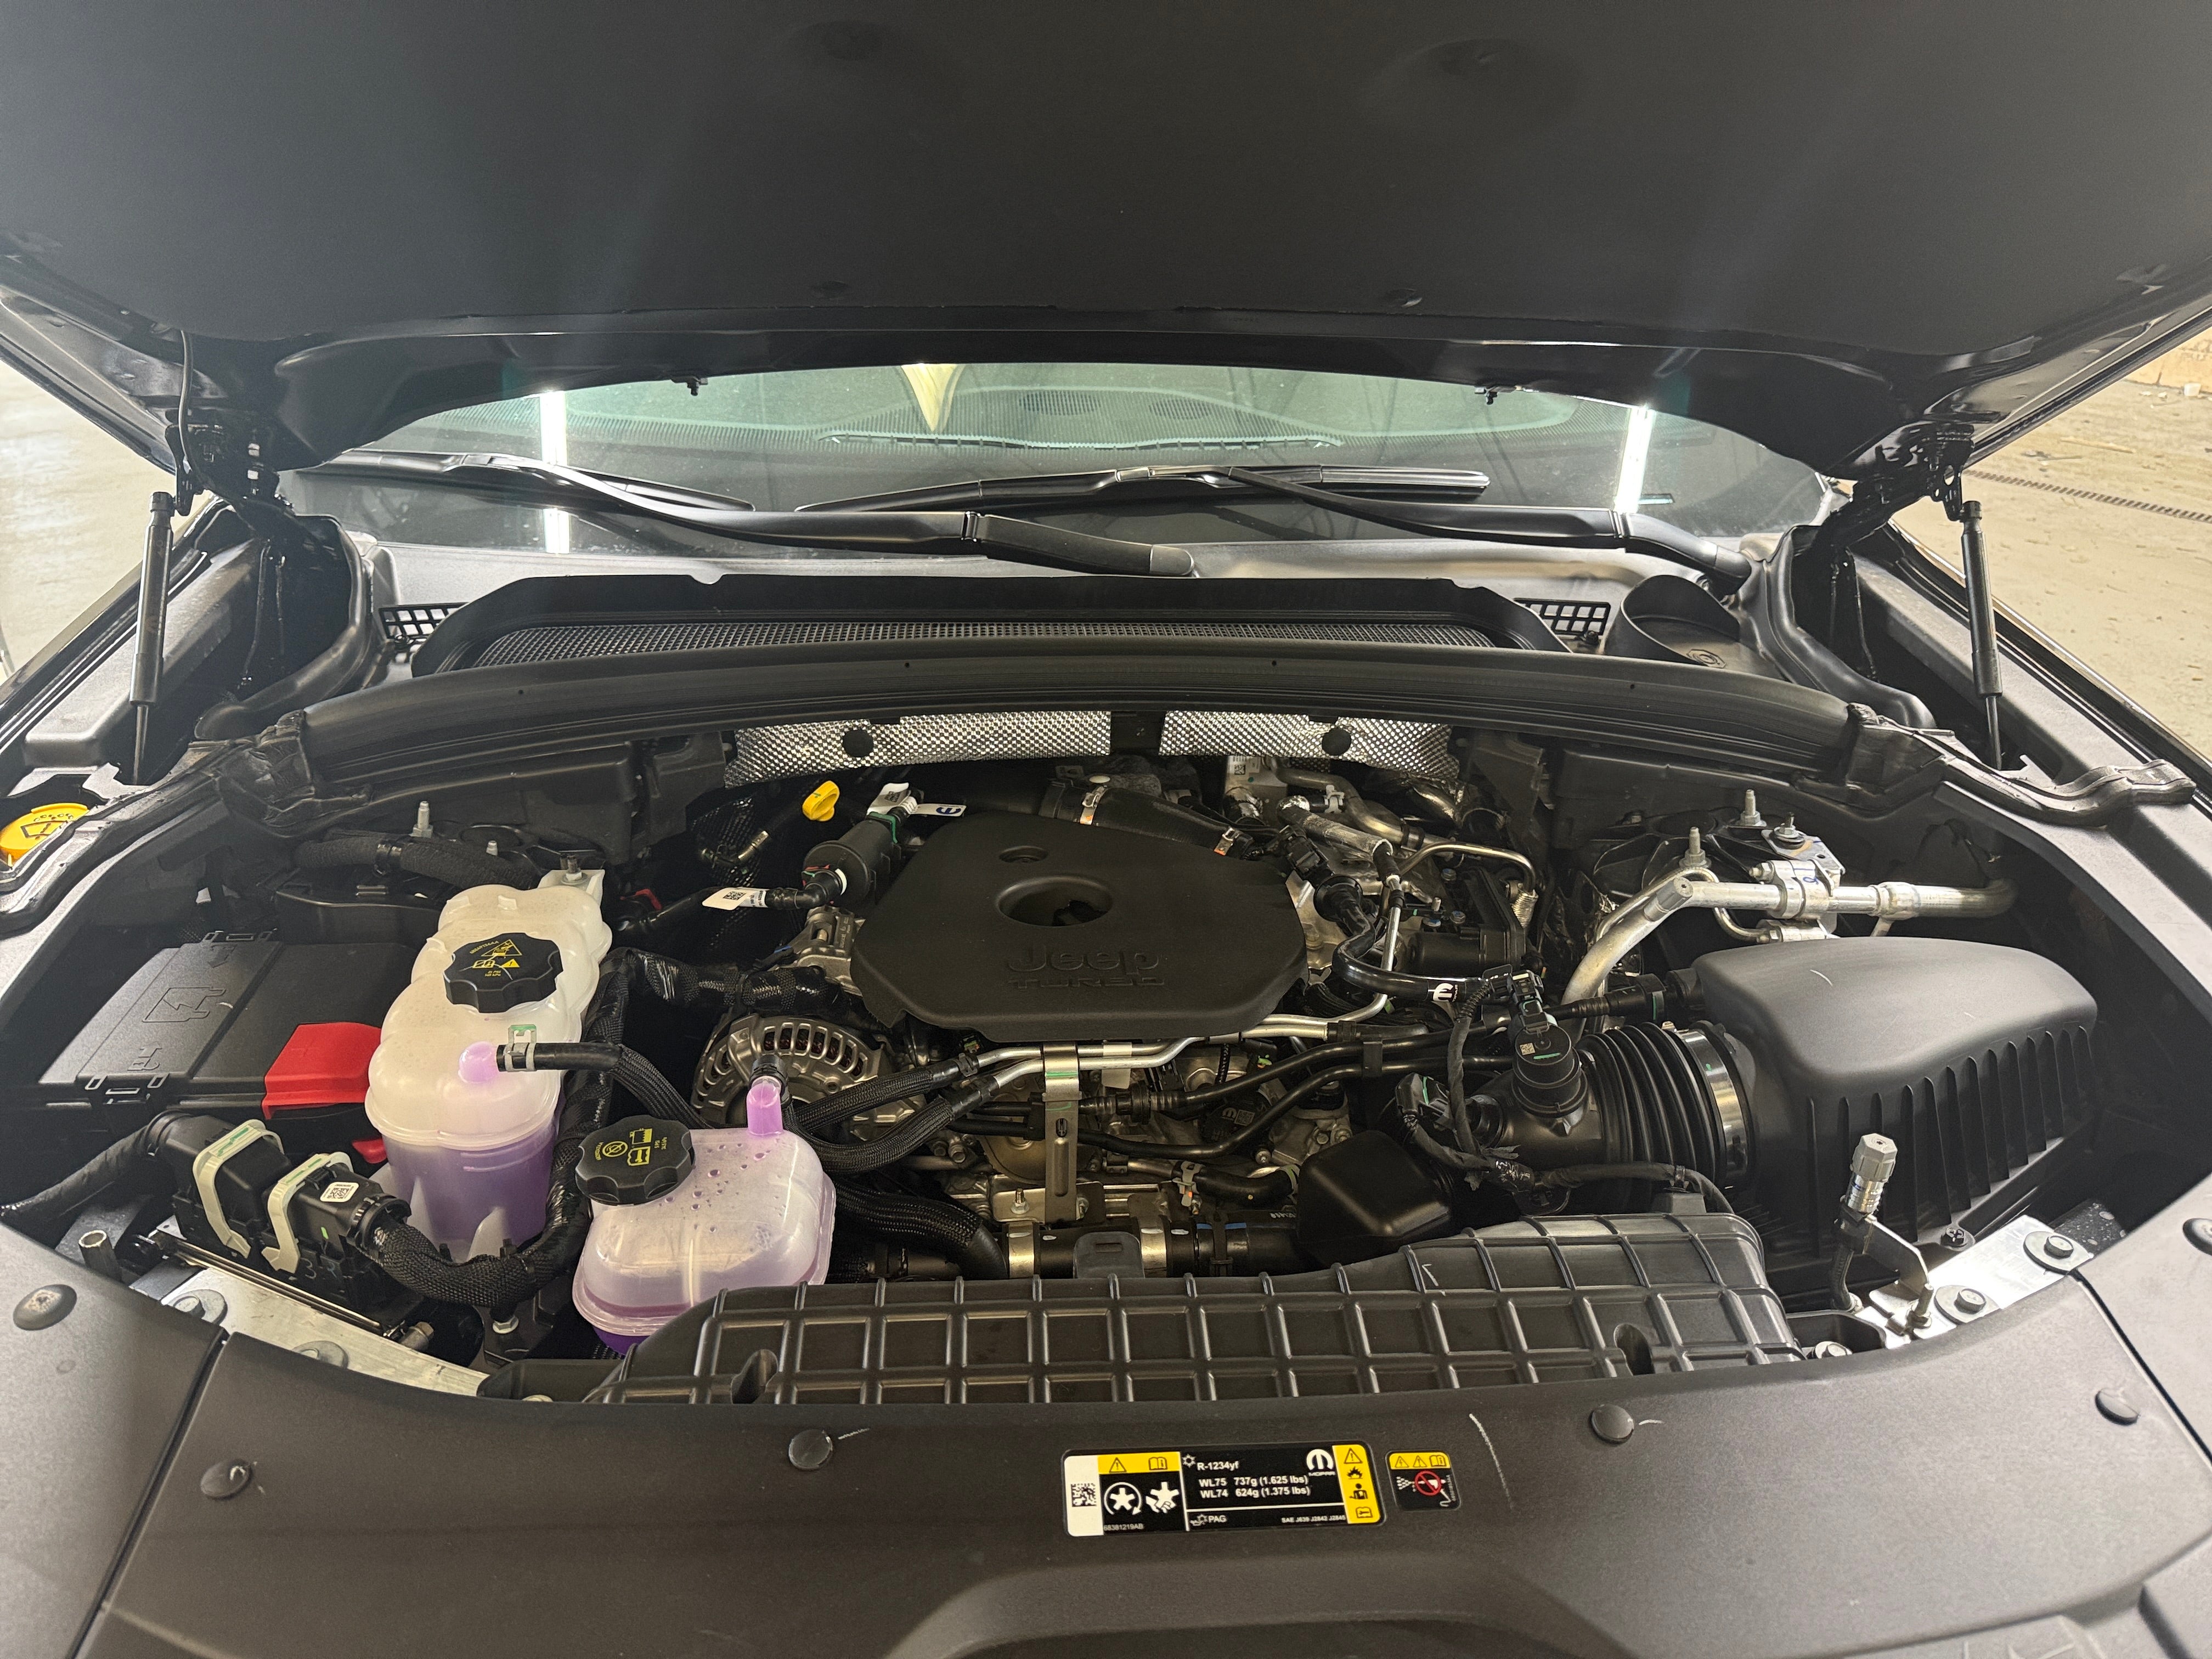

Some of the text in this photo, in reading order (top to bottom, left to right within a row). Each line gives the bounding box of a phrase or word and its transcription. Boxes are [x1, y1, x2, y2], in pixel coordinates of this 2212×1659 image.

[1008, 944, 1160, 975] Jeep
[1008, 977, 1165, 989] TURBO
[1197, 1460, 1239, 1471] R-1234yf
[1198, 1475, 1310, 1487] WL75 737g (1.625 lbs)
[1199, 1486, 1312, 1498] WL74 624g (1.375 lbs)
[1208, 1515, 1227, 1523] PAG
